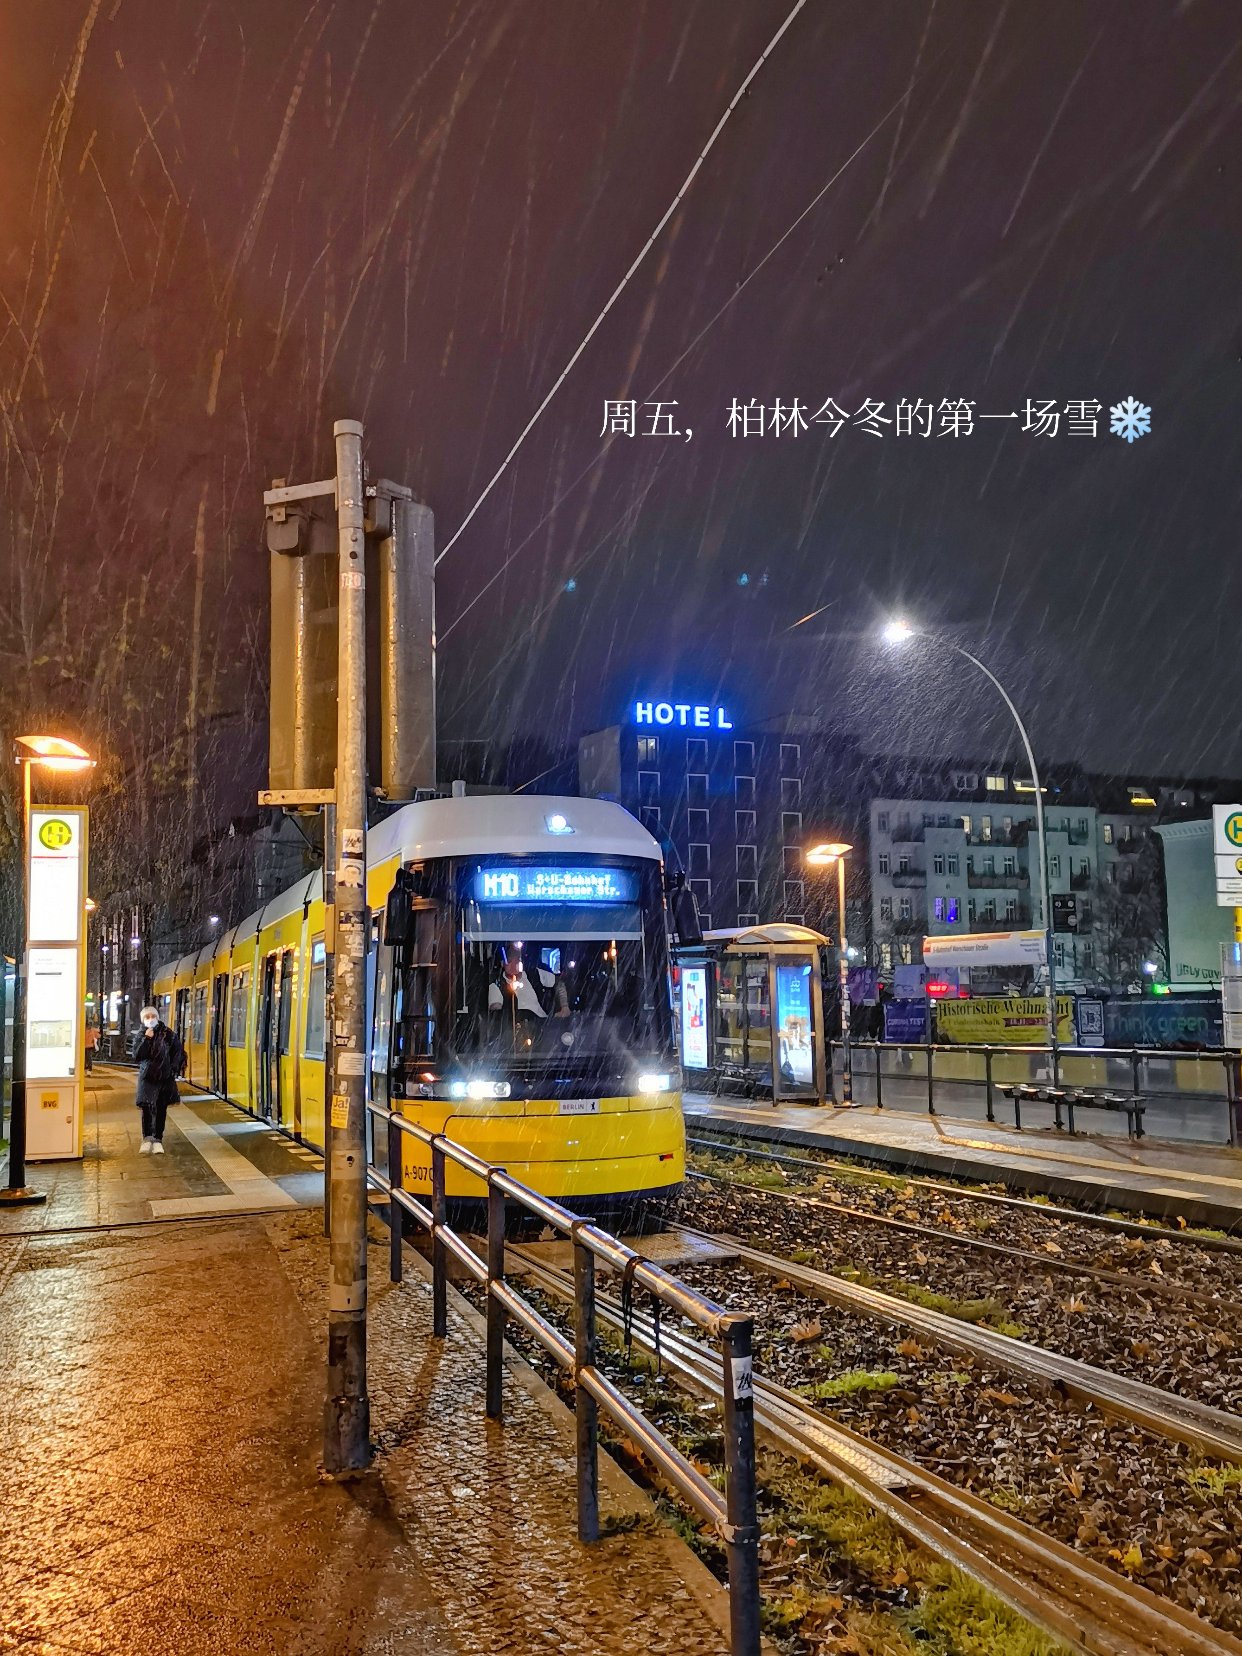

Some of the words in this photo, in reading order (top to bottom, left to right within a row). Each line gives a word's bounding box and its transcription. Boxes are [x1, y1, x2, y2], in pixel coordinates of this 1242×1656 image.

[636, 702, 733, 729] HOTEL
[483, 873, 519, 897] M10
[938, 1000, 1000, 1019] Historische
[1107, 1013, 1152, 1032] Think
[1158, 1016, 1209, 1036] green
[333, 1096, 349, 1109] Ja!
